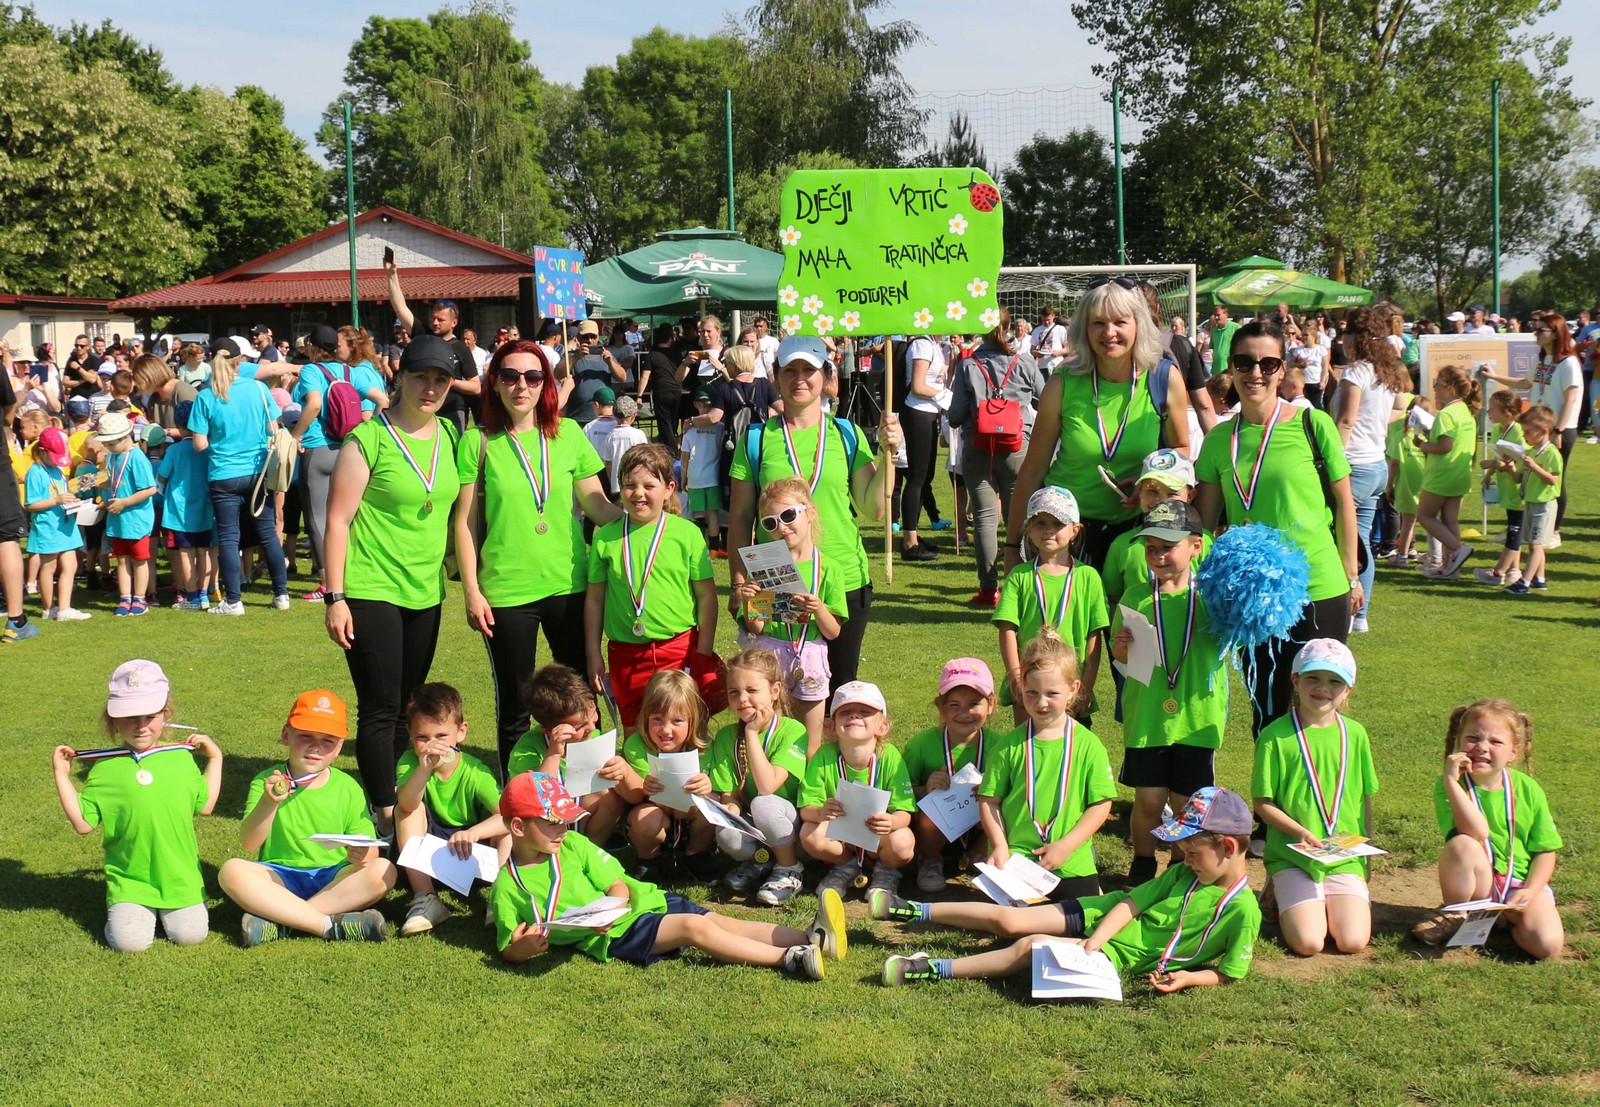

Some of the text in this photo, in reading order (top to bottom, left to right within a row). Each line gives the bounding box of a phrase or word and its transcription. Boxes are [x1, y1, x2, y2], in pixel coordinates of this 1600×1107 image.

[796, 178, 948, 225] DJEČJI VRTIĆ
[797, 235, 968, 278] MALA TRATINČICA
[659, 260, 737, 276] PAN
[685, 287, 709, 296] PAN
[836, 280, 909, 306] PODTUREN
[1336, 295, 1356, 303] PAN
